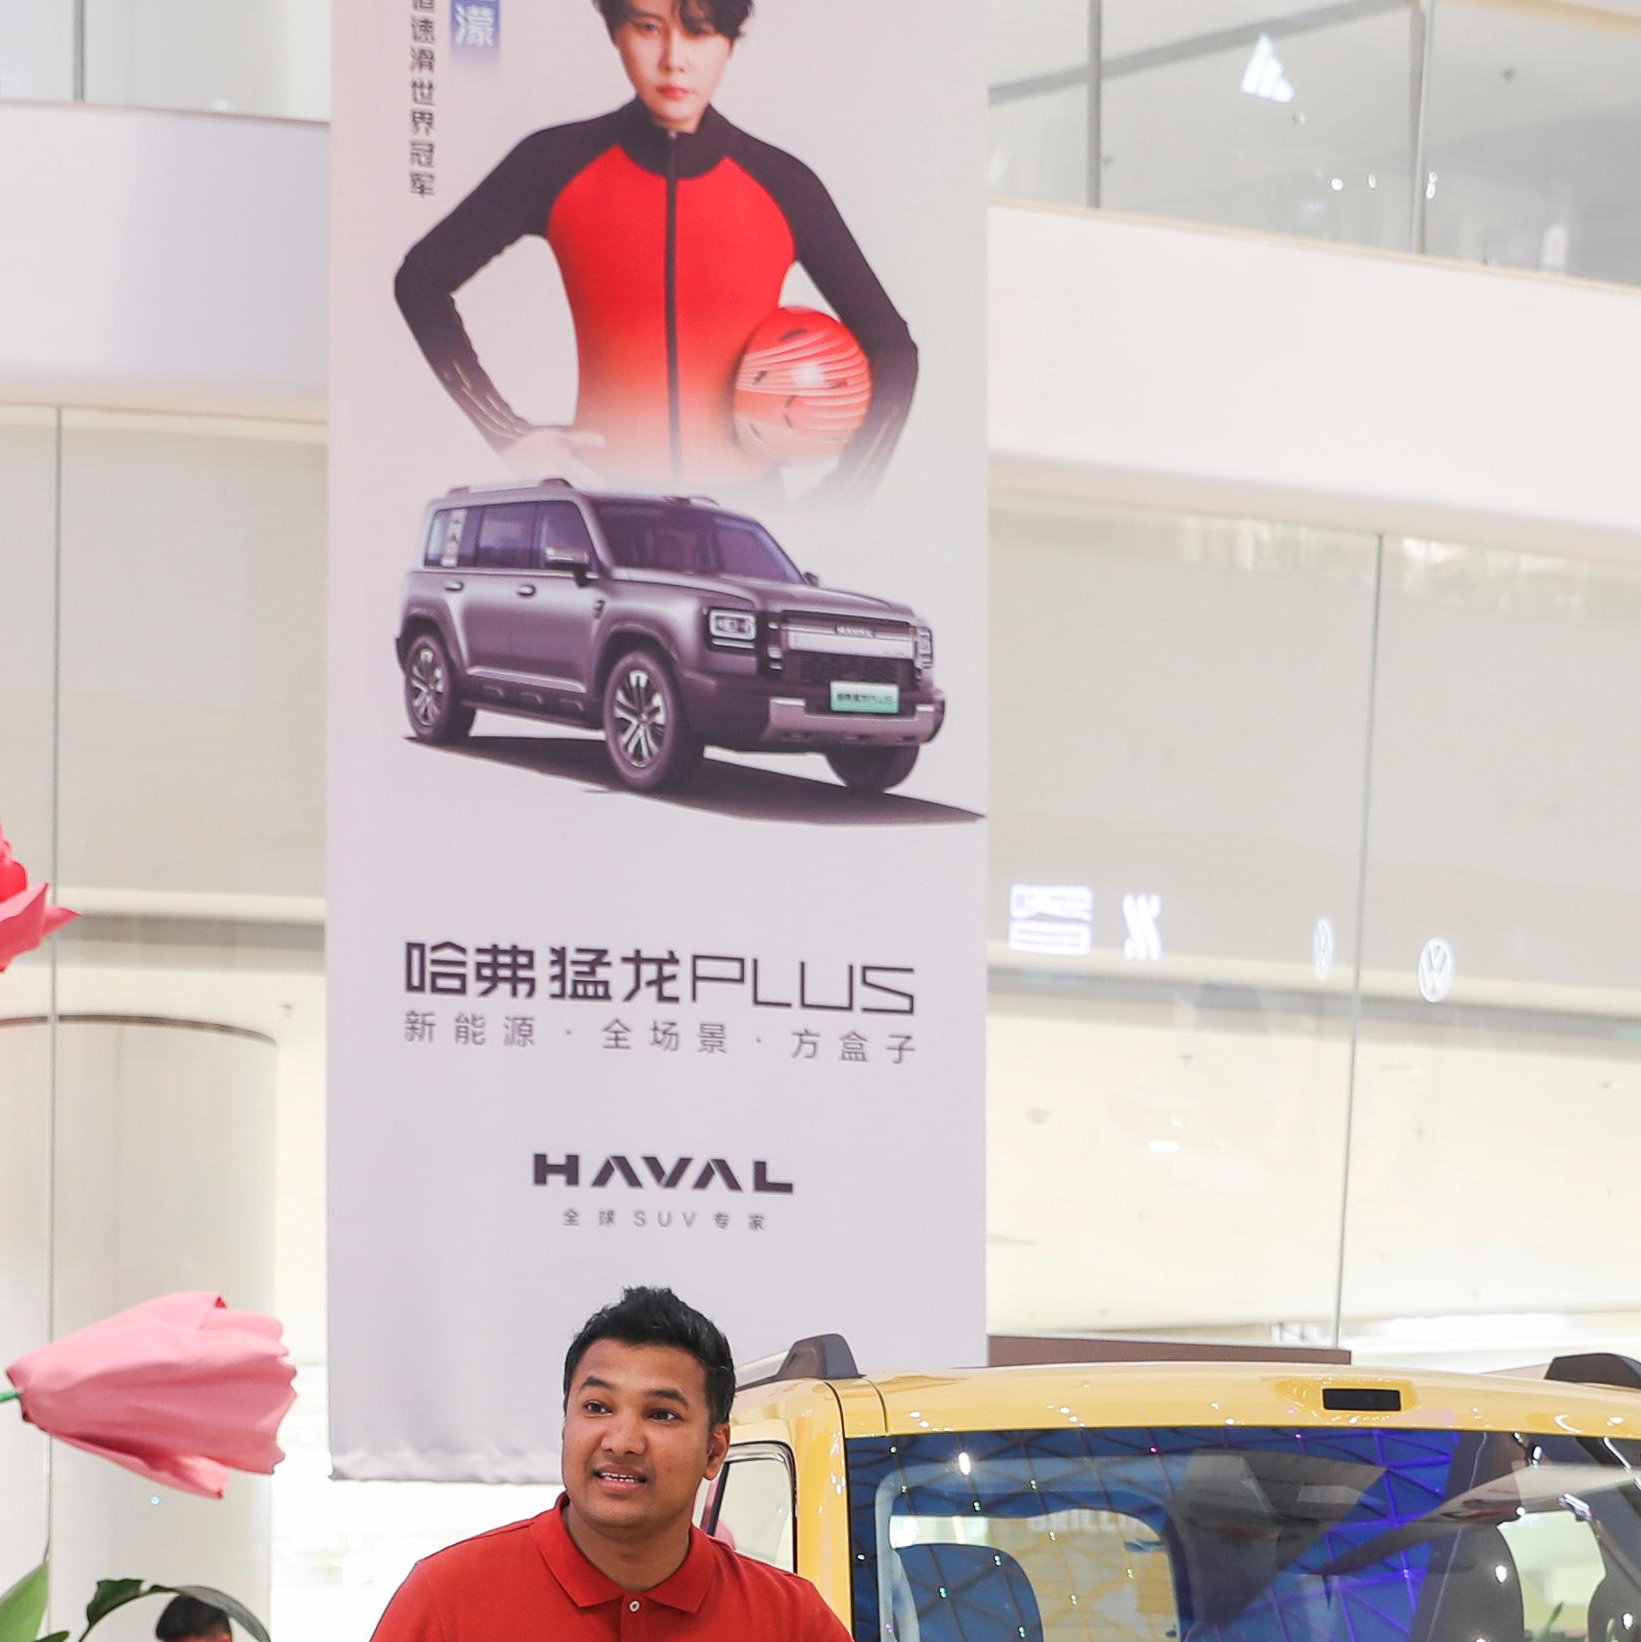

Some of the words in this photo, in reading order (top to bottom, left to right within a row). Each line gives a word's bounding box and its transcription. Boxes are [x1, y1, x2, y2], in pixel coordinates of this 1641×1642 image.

[455, 0, 496, 46] 濛
[405, 941, 914, 1015] 哈弗猛龙PLUS
[533, 1154, 793, 1194] HAVAL
